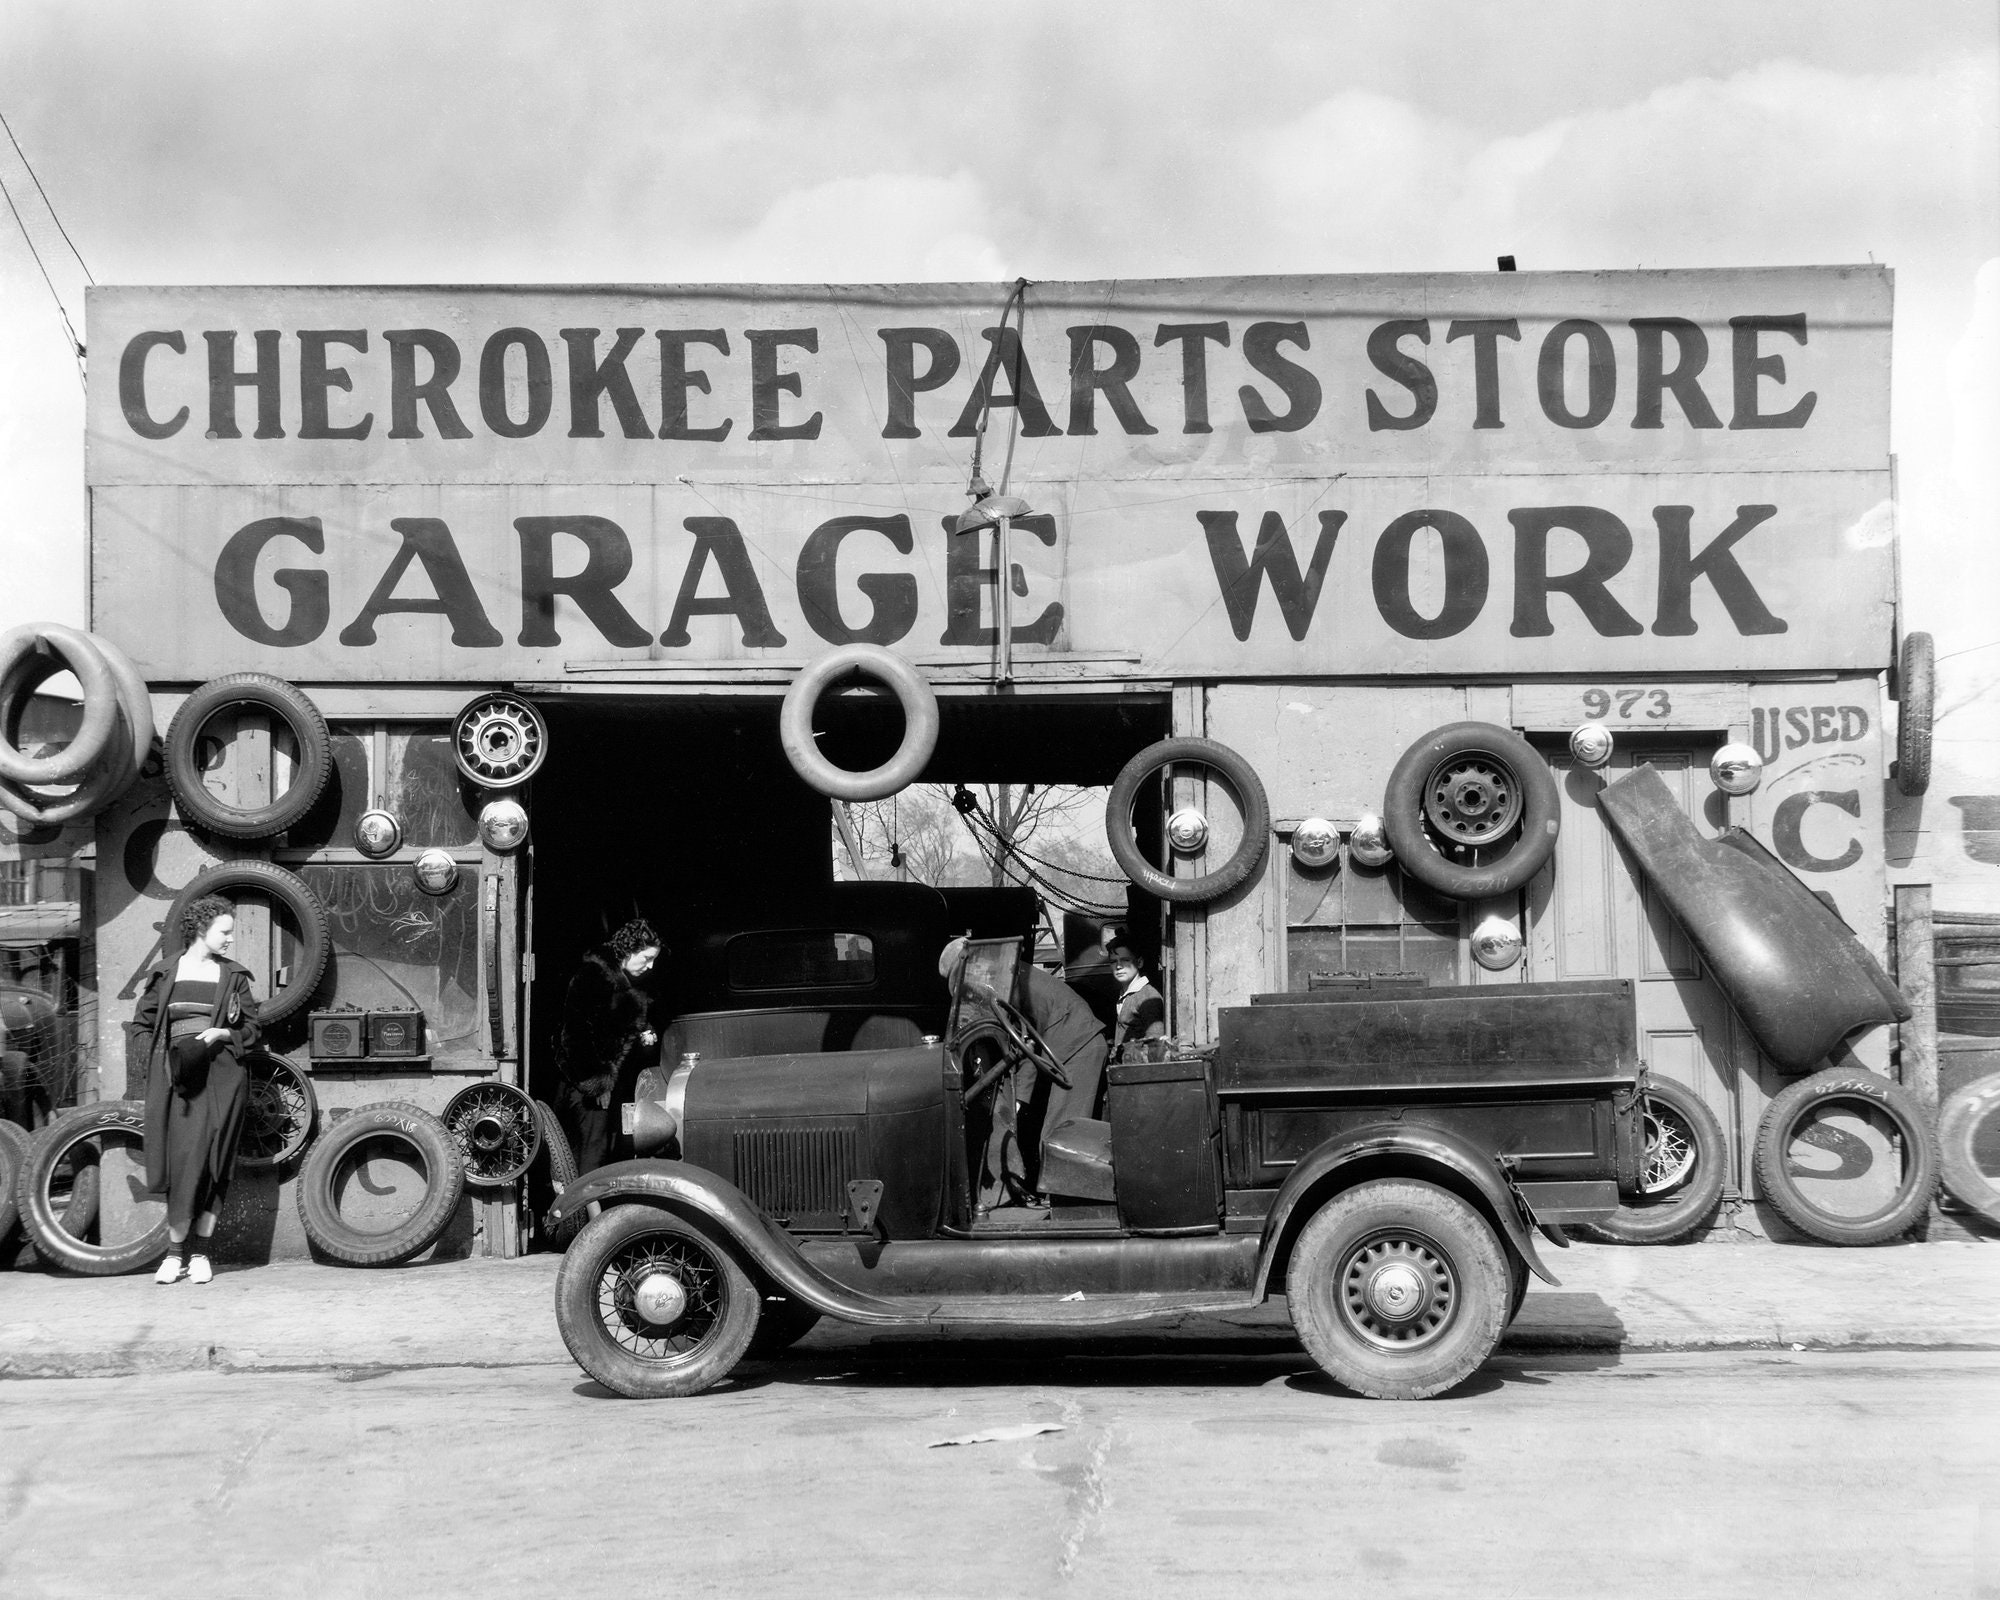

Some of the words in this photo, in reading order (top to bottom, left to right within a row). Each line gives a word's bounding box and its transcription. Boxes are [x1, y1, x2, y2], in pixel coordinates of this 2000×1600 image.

[118, 326, 824, 442] CHEROKEE
[877, 318, 1324, 441] PARTS
[1364, 311, 1818, 434] STORE
[212, 512, 1065, 649] GARAGE
[1195, 503, 1790, 642] WORK
[1582, 688, 1672, 719] 973
[1751, 705, 1869, 767] USED
